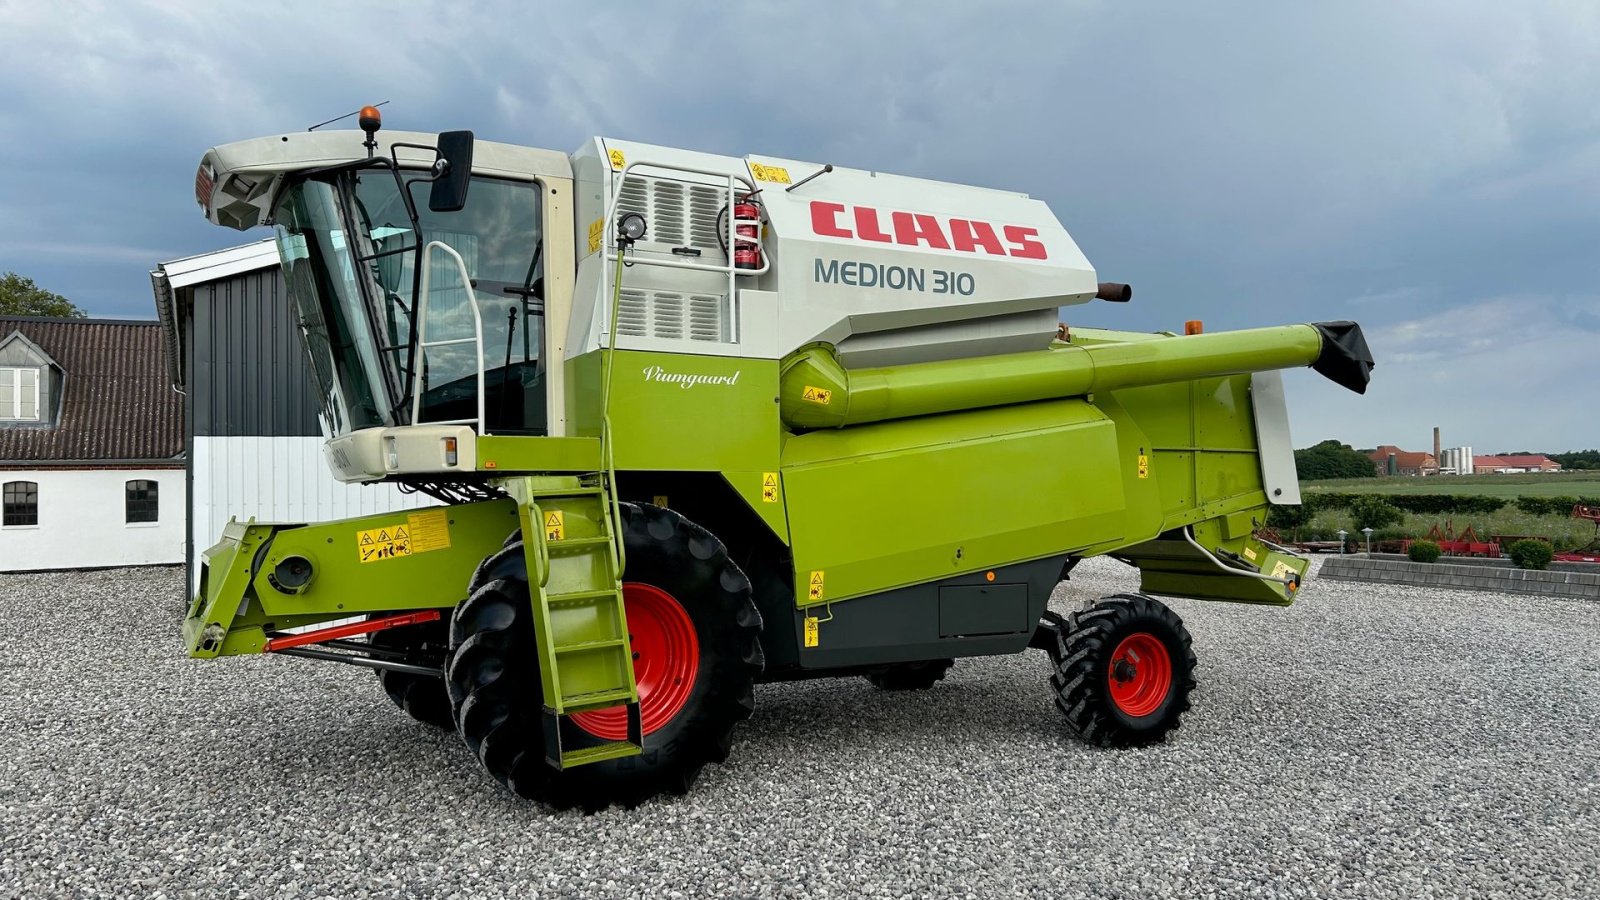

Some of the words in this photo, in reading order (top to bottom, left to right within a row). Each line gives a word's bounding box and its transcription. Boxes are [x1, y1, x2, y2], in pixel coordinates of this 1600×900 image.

[810, 200, 1047, 261] CLAAS
[814, 258, 925, 292] MEDION
[932, 269, 976, 297] 310
[642, 366, 741, 389] Viumgaard
